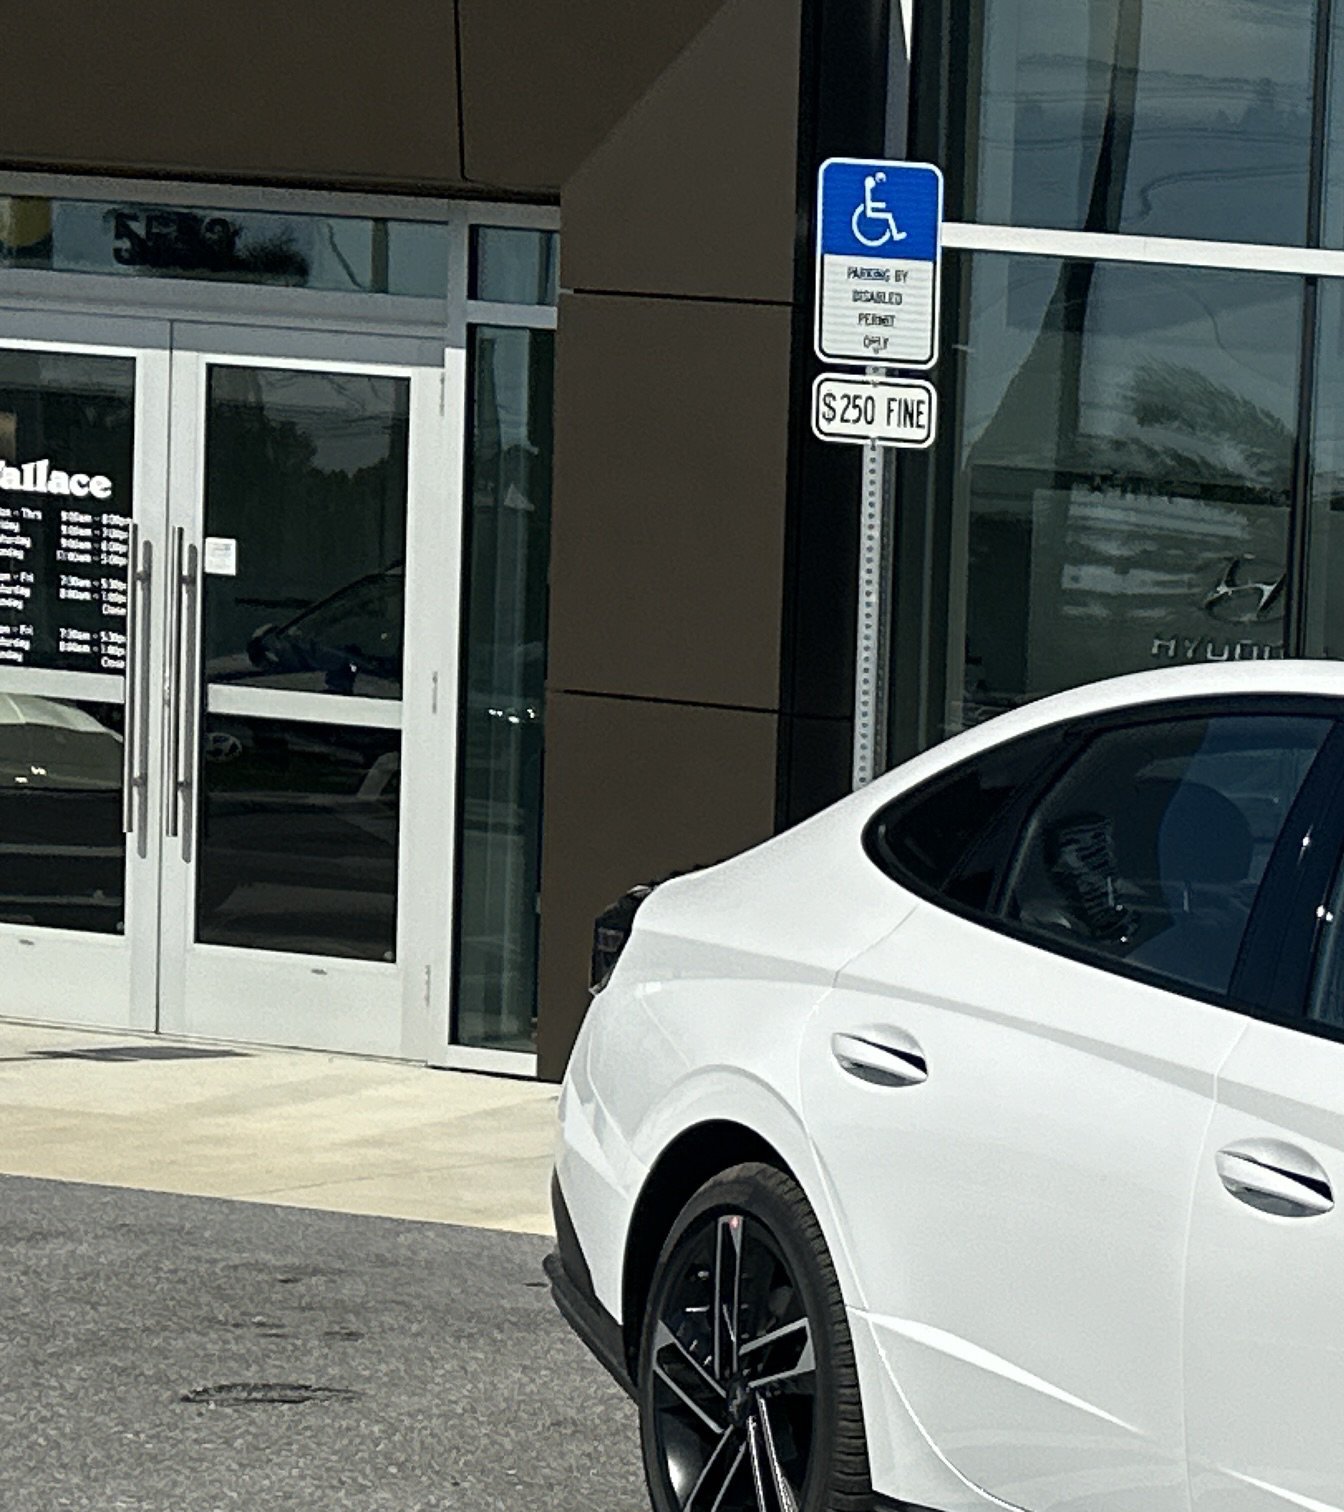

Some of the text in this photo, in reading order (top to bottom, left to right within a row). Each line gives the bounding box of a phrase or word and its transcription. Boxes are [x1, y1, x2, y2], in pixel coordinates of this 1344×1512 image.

[894, 269, 908, 283] BY
[822, 392, 926, 429] $250 FINE
[0, 459, 112, 498] allace
